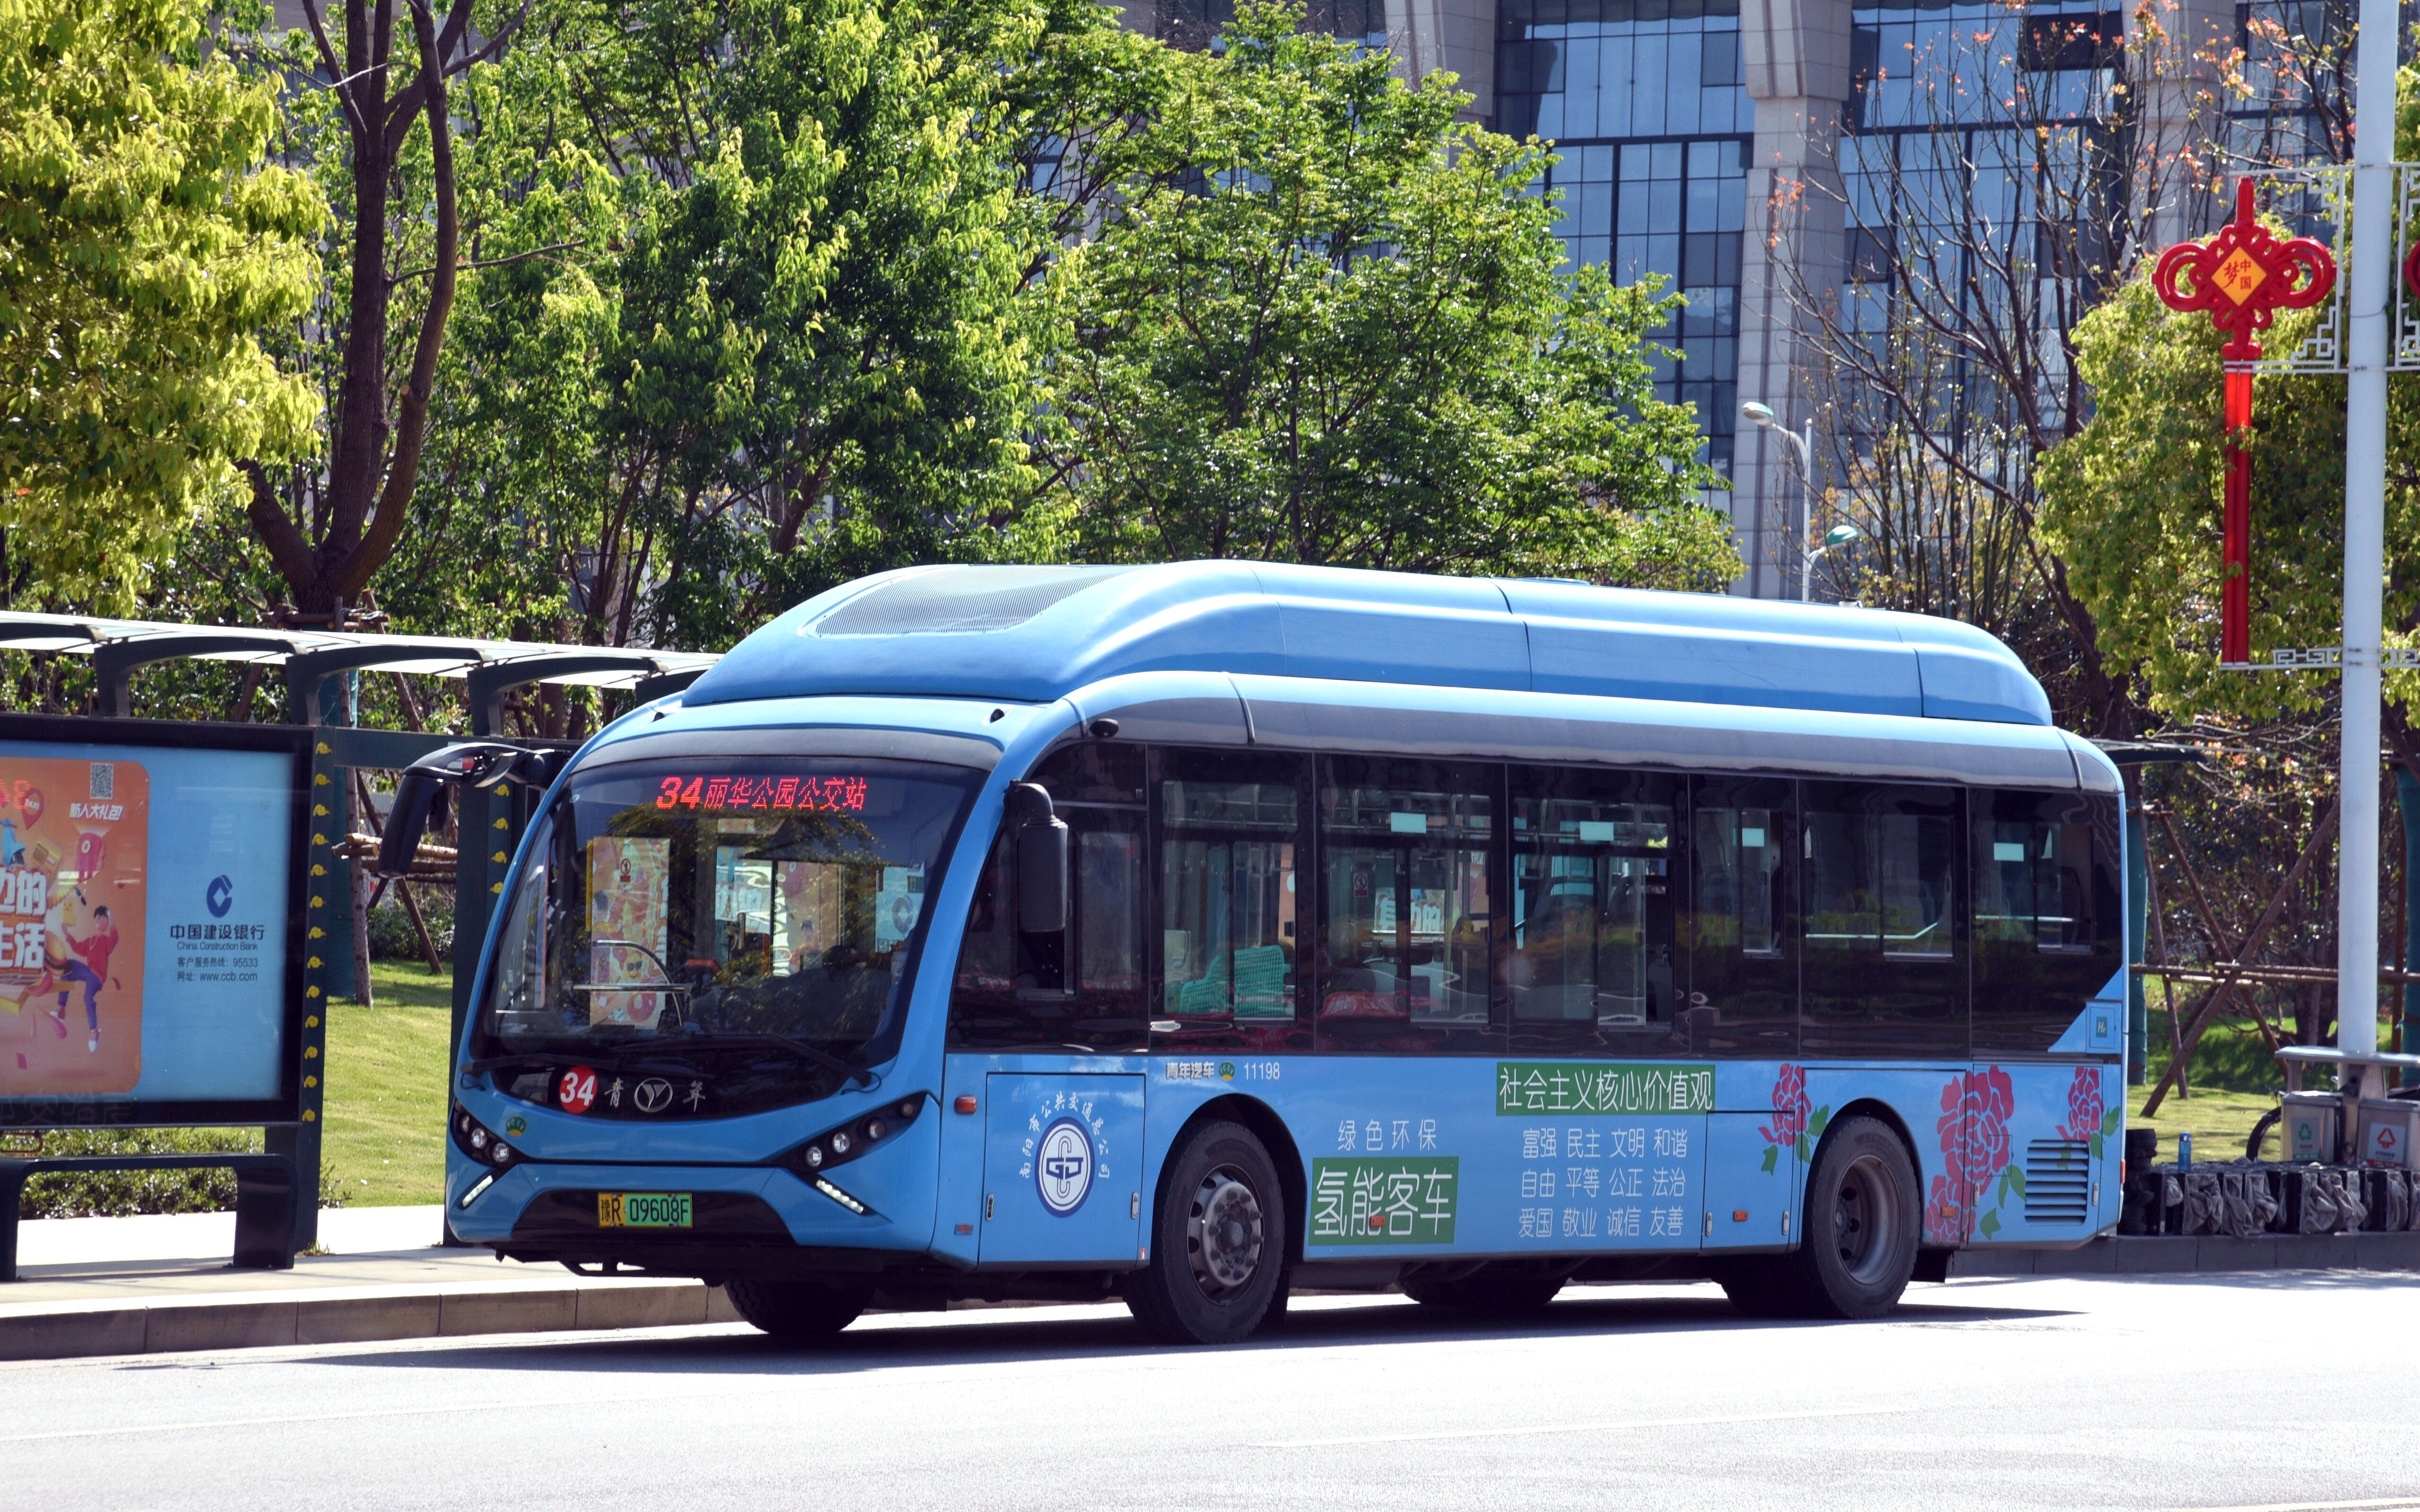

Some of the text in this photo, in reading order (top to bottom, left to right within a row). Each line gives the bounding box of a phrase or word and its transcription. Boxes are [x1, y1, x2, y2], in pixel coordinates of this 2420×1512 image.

[2223, 261, 2240, 289] 梦
[657, 777, 868, 811] 34 丽华公园公交站
[69, 802, 123, 821] 新人大礼包
[170, 924, 265, 941] 中国建设银行
[177, 941, 258, 951] China Construction Bank
[199, 970, 258, 982] www.ccb.com
[233, 957, 259, 968] 95533
[1166, 1061, 1215, 1080] 青年汽车
[1244, 1062, 1280, 1081] 11198
[560, 1071, 596, 1107] 34
[1499, 1066, 1713, 1111] 社会主义核心价值观
[1338, 1118, 1437, 1151] 绿色环保
[1523, 1127, 1688, 1158] 富强 民主 文明 和谐
[1521, 1167, 1686, 1198] 自由 平等 公正 法治
[629, 1198, 690, 1223] 09608F
[1314, 1166, 1452, 1237] 氢能客车
[1519, 1205, 1684, 1238] 爱国 敬业 诚信 友善
